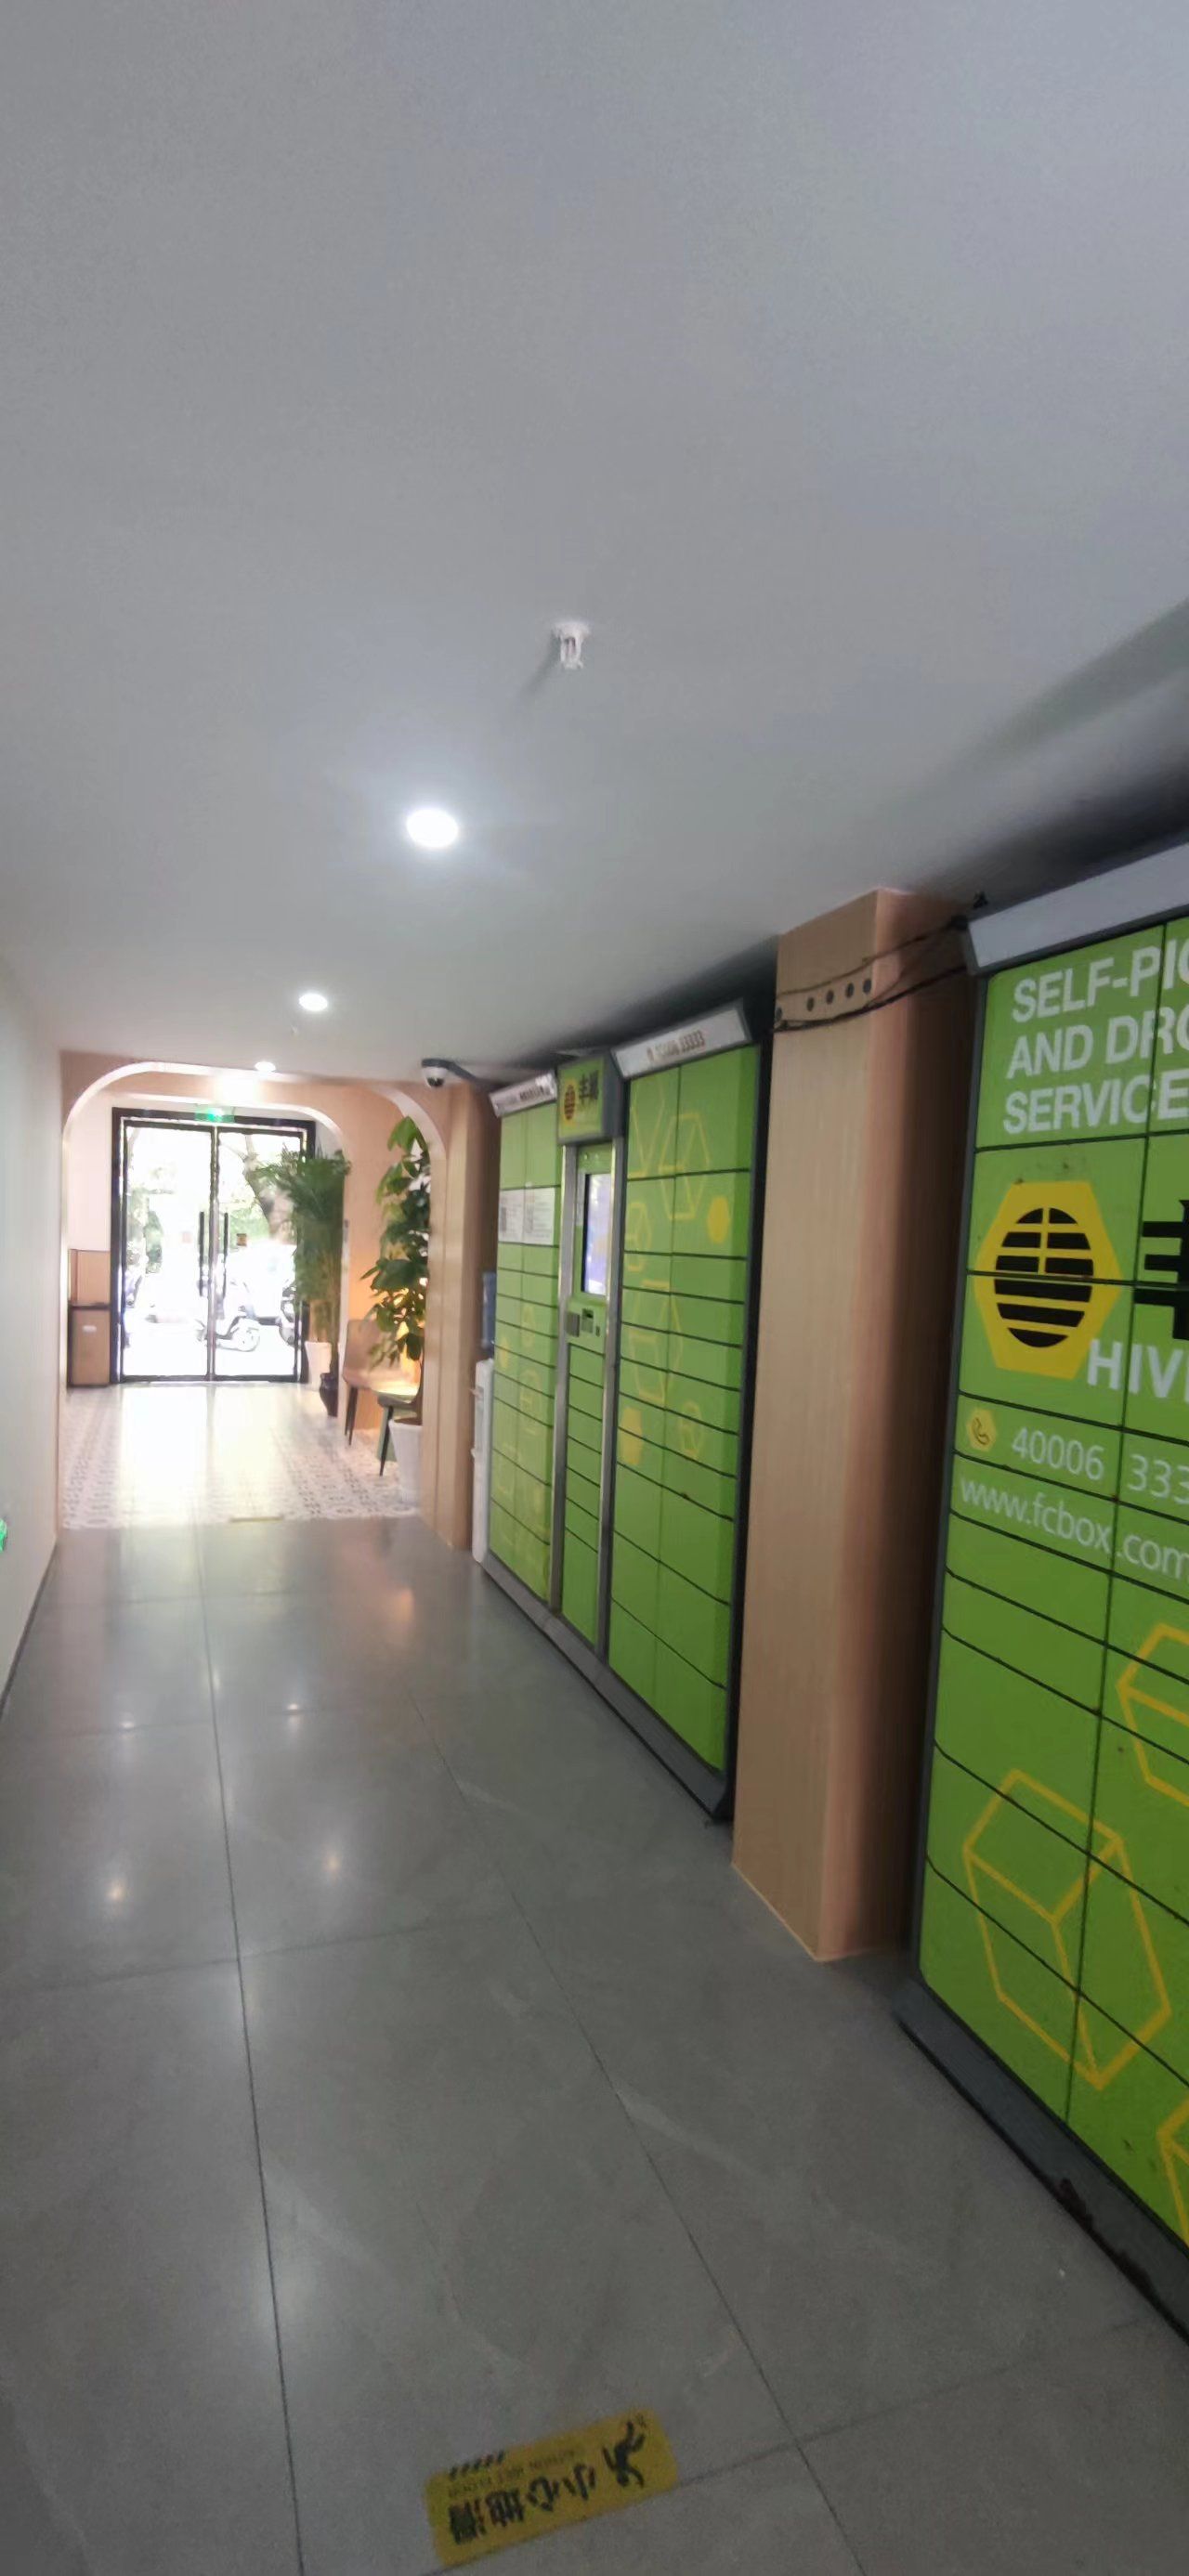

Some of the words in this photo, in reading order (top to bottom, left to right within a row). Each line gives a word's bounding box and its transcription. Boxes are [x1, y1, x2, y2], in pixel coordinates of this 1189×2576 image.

[1006, 1024, 1094, 1080] AND
[1003, 1069, 1189, 1135] SERVICE
[1087, 1338, 1189, 1404] HIV
[1012, 1426, 1105, 1481] 40006
[960, 1477, 1189, 1582] www.fcbox.com
